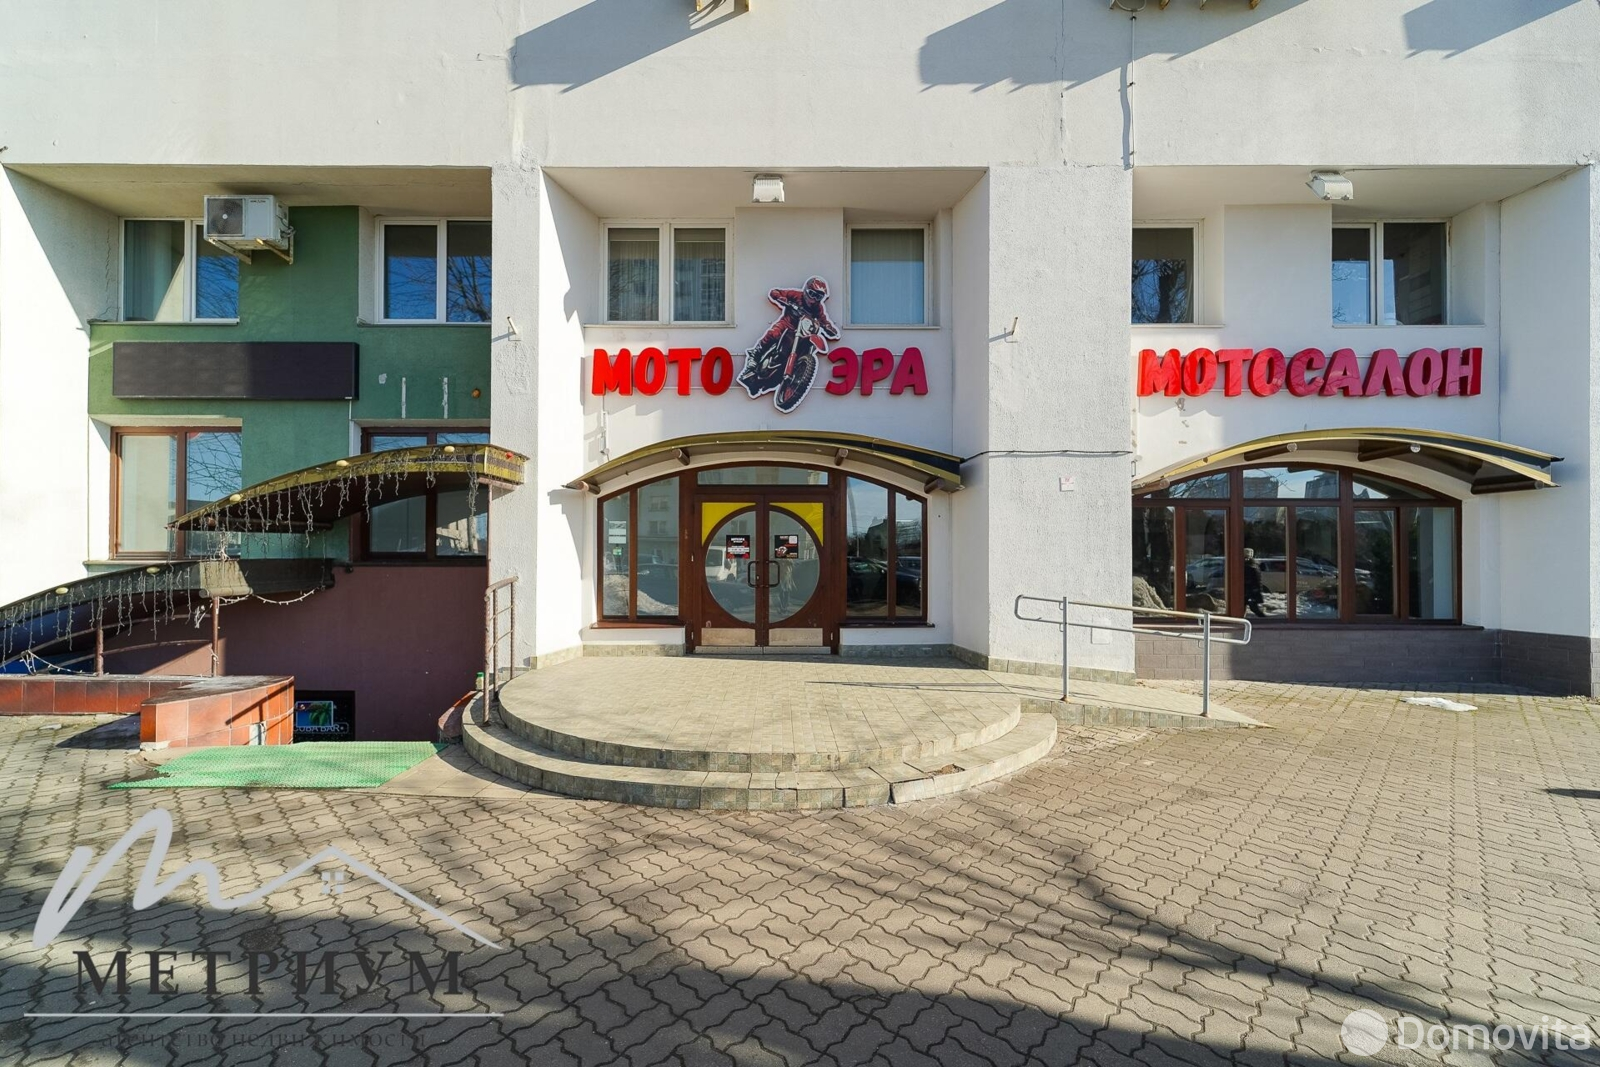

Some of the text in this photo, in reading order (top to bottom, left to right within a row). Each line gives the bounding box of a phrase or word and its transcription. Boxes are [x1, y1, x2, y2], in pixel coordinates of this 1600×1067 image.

[592, 347, 928, 396] МОТО ЭРА
[1137, 347, 1482, 398] МОТОСАЛОН
